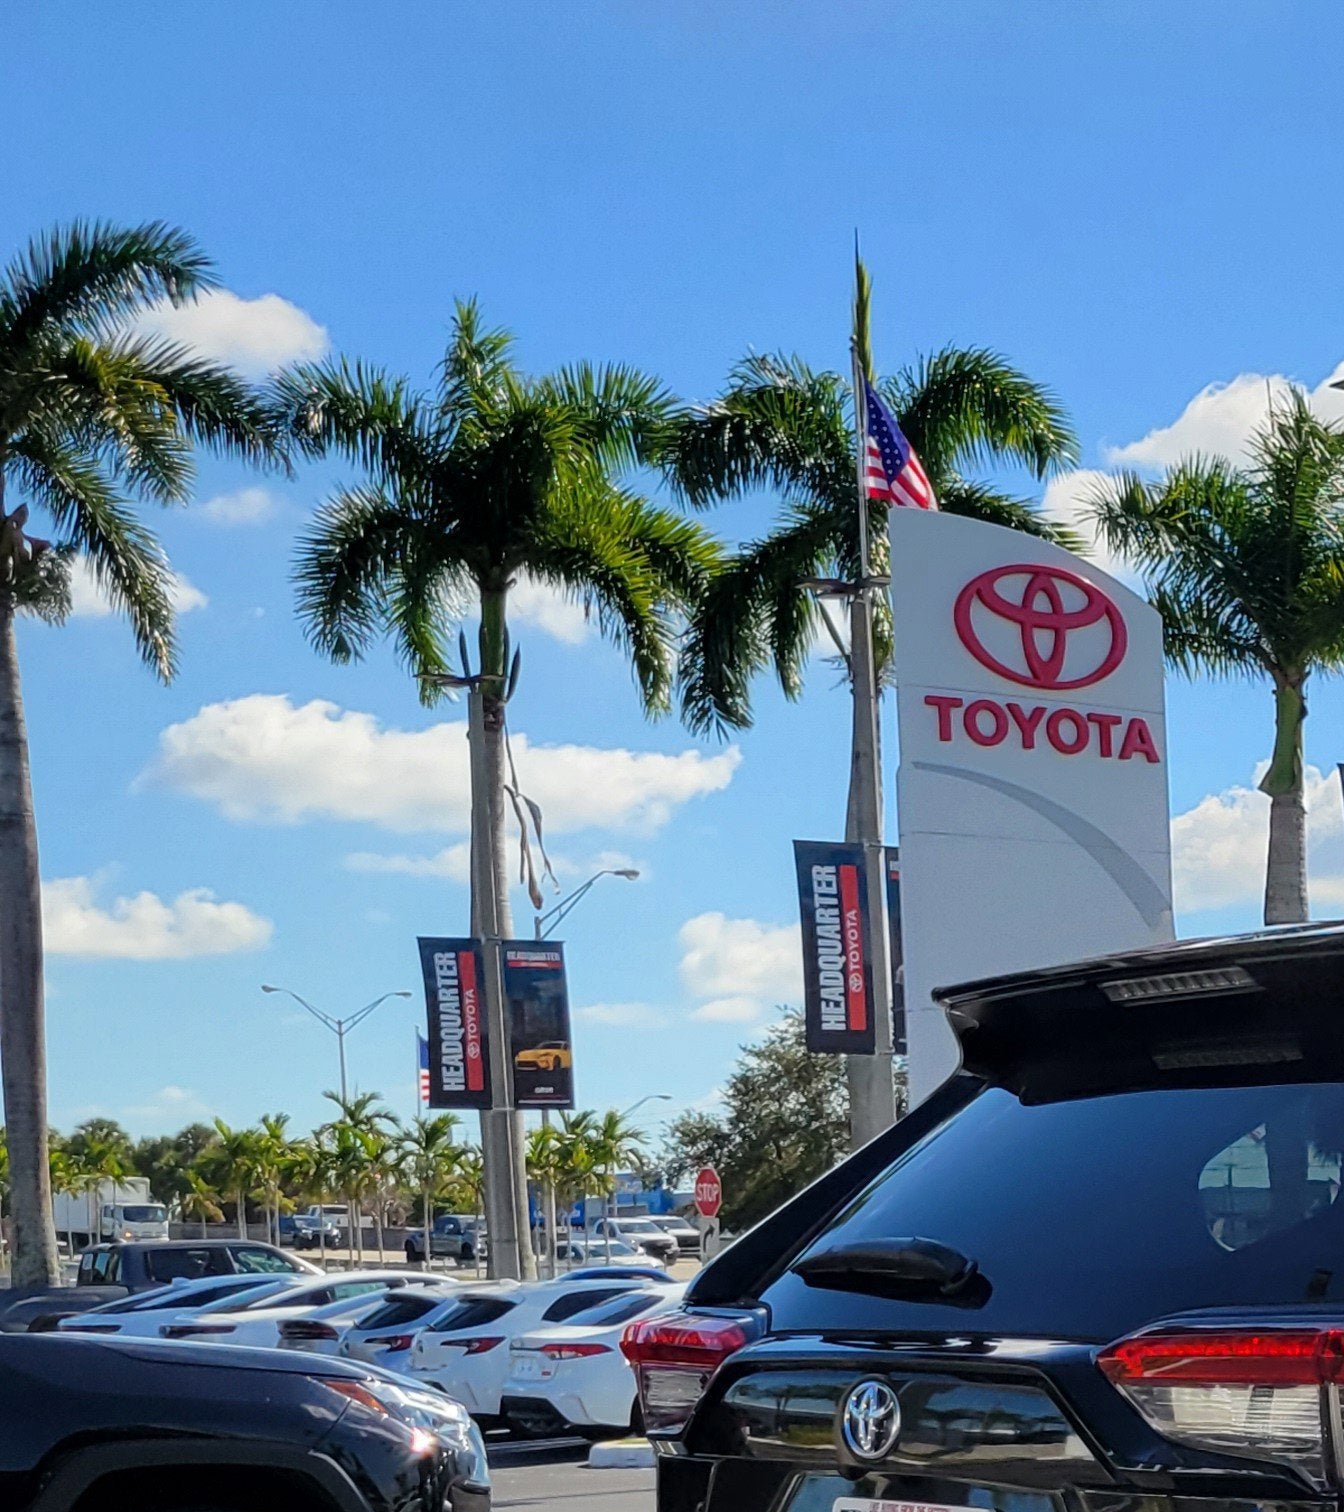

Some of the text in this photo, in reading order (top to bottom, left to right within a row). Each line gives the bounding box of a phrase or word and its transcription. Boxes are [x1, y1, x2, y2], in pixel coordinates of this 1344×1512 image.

[924, 695, 1160, 763] TOYOTA
[812, 864, 846, 1031] HEADQUARTER
[847, 909, 861, 971] TOYOTA
[433, 951, 465, 1091] HEADQUARTER
[464, 988, 477, 1041] TOYOTA
[697, 1183, 720, 1202] STOP
